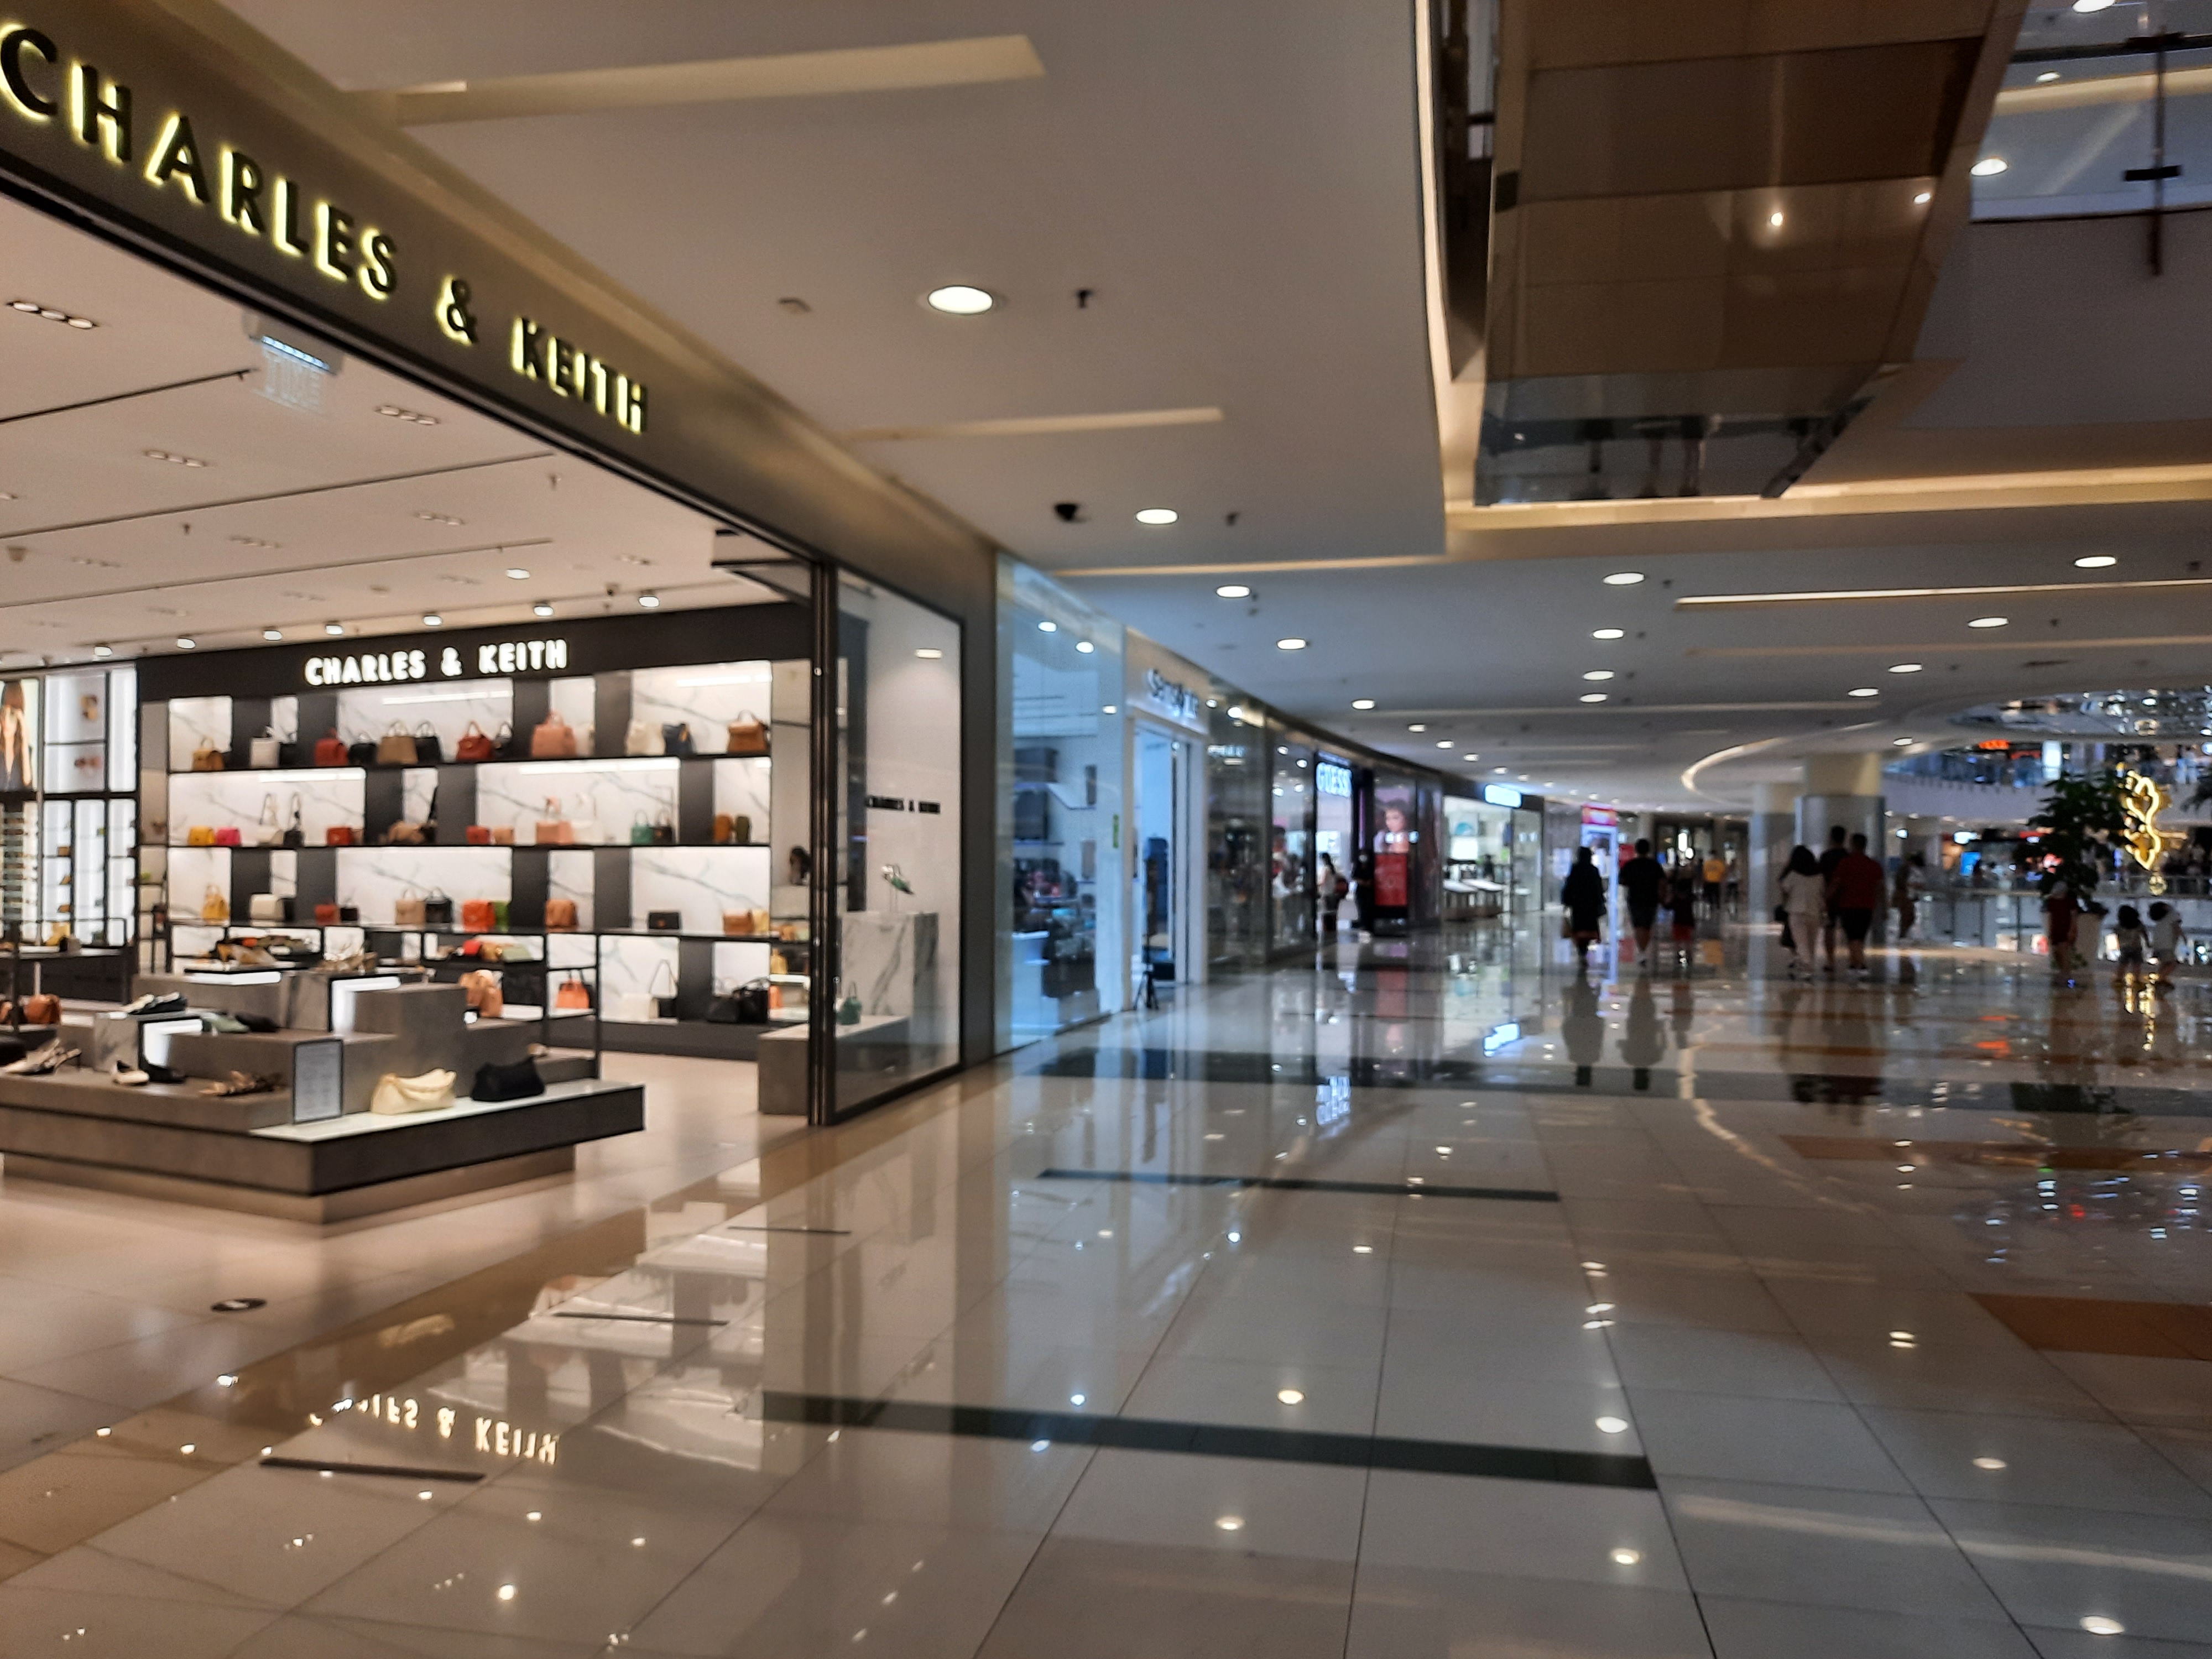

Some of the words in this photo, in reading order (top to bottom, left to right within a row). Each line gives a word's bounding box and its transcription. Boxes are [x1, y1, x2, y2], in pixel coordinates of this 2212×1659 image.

[0, 21, 398, 300] CHARLES
[436, 275, 478, 347] &
[511, 315, 648, 435] KEITH
[303, 648, 427, 686] CHARLES
[441, 646, 463, 677] &
[478, 638, 567, 675] KEITH
